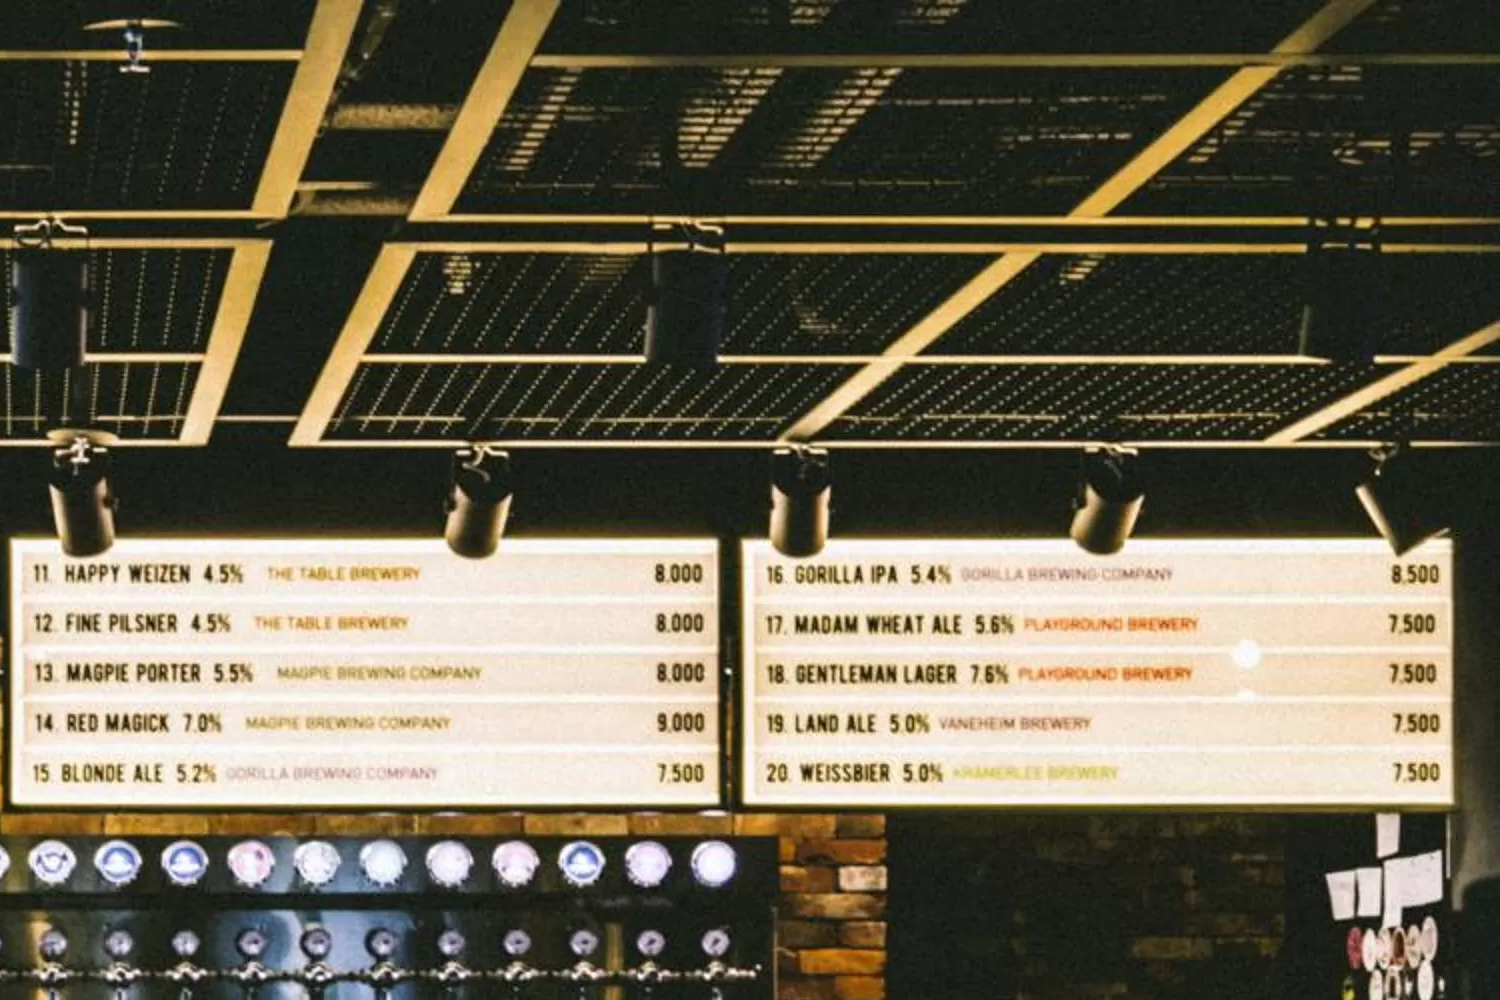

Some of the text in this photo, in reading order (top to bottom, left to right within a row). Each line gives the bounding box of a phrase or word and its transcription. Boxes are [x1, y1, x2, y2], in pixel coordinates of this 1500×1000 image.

[64, 564, 121, 581] HAPPY
[127, 564, 191, 583] WEIZEN
[267, 567, 296, 580] THE
[299, 567, 345, 581] TABLE
[348, 567, 422, 580] BREWERY
[794, 566, 864, 584] GORILLA
[870, 565, 899, 583] IPA
[960, 569, 1024, 581] GORILLA
[1027, 569, 1098, 580] BREWING
[1100, 569, 1173, 580] COMPANY
[64, 614, 103, 632] FINE
[107, 614, 178, 632] PILSNER
[253, 616, 282, 630] THE
[286, 617, 333, 630] TABLE
[336, 617, 410, 629] BREWERY
[794, 616, 859, 634] MADAM
[865, 615, 925, 634] WHEAT
[931, 615, 963, 634] ALE
[1023, 618, 1124, 630] PLAYGROUND
[1126, 618, 1199, 631] BREWERY
[65, 663, 130, 682] MAGPIE
[135, 663, 202, 682] PORTER
[276, 667, 332, 680] MAGPIE
[336, 666, 407, 680] BREWING
[409, 667, 483, 679] COMPANY
[795, 665, 898, 683] GENTLEMAN
[903, 664, 958, 684] LAGER
[1017, 667, 1118, 681] PLAYGROUND
[1121, 667, 1193, 681] BREWERY
[65, 714, 100, 732] RED
[104, 714, 170, 732] MAGICK
[244, 717, 301, 729] MAGPIE
[305, 717, 375, 729] BREWING
[377, 717, 452, 729] COMPANY
[794, 714, 840, 733] LAND
[845, 714, 877, 733] ALE
[1018, 717, 1092, 730] BREWERY
[60, 764, 126, 782] BLONDE
[131, 764, 164, 782] ALE
[226, 767, 289, 779] GORILLA
[292, 768, 362, 779] BREWING
[365, 768, 438, 779] COMPANY
[799, 764, 891, 782] WEISSBIER
